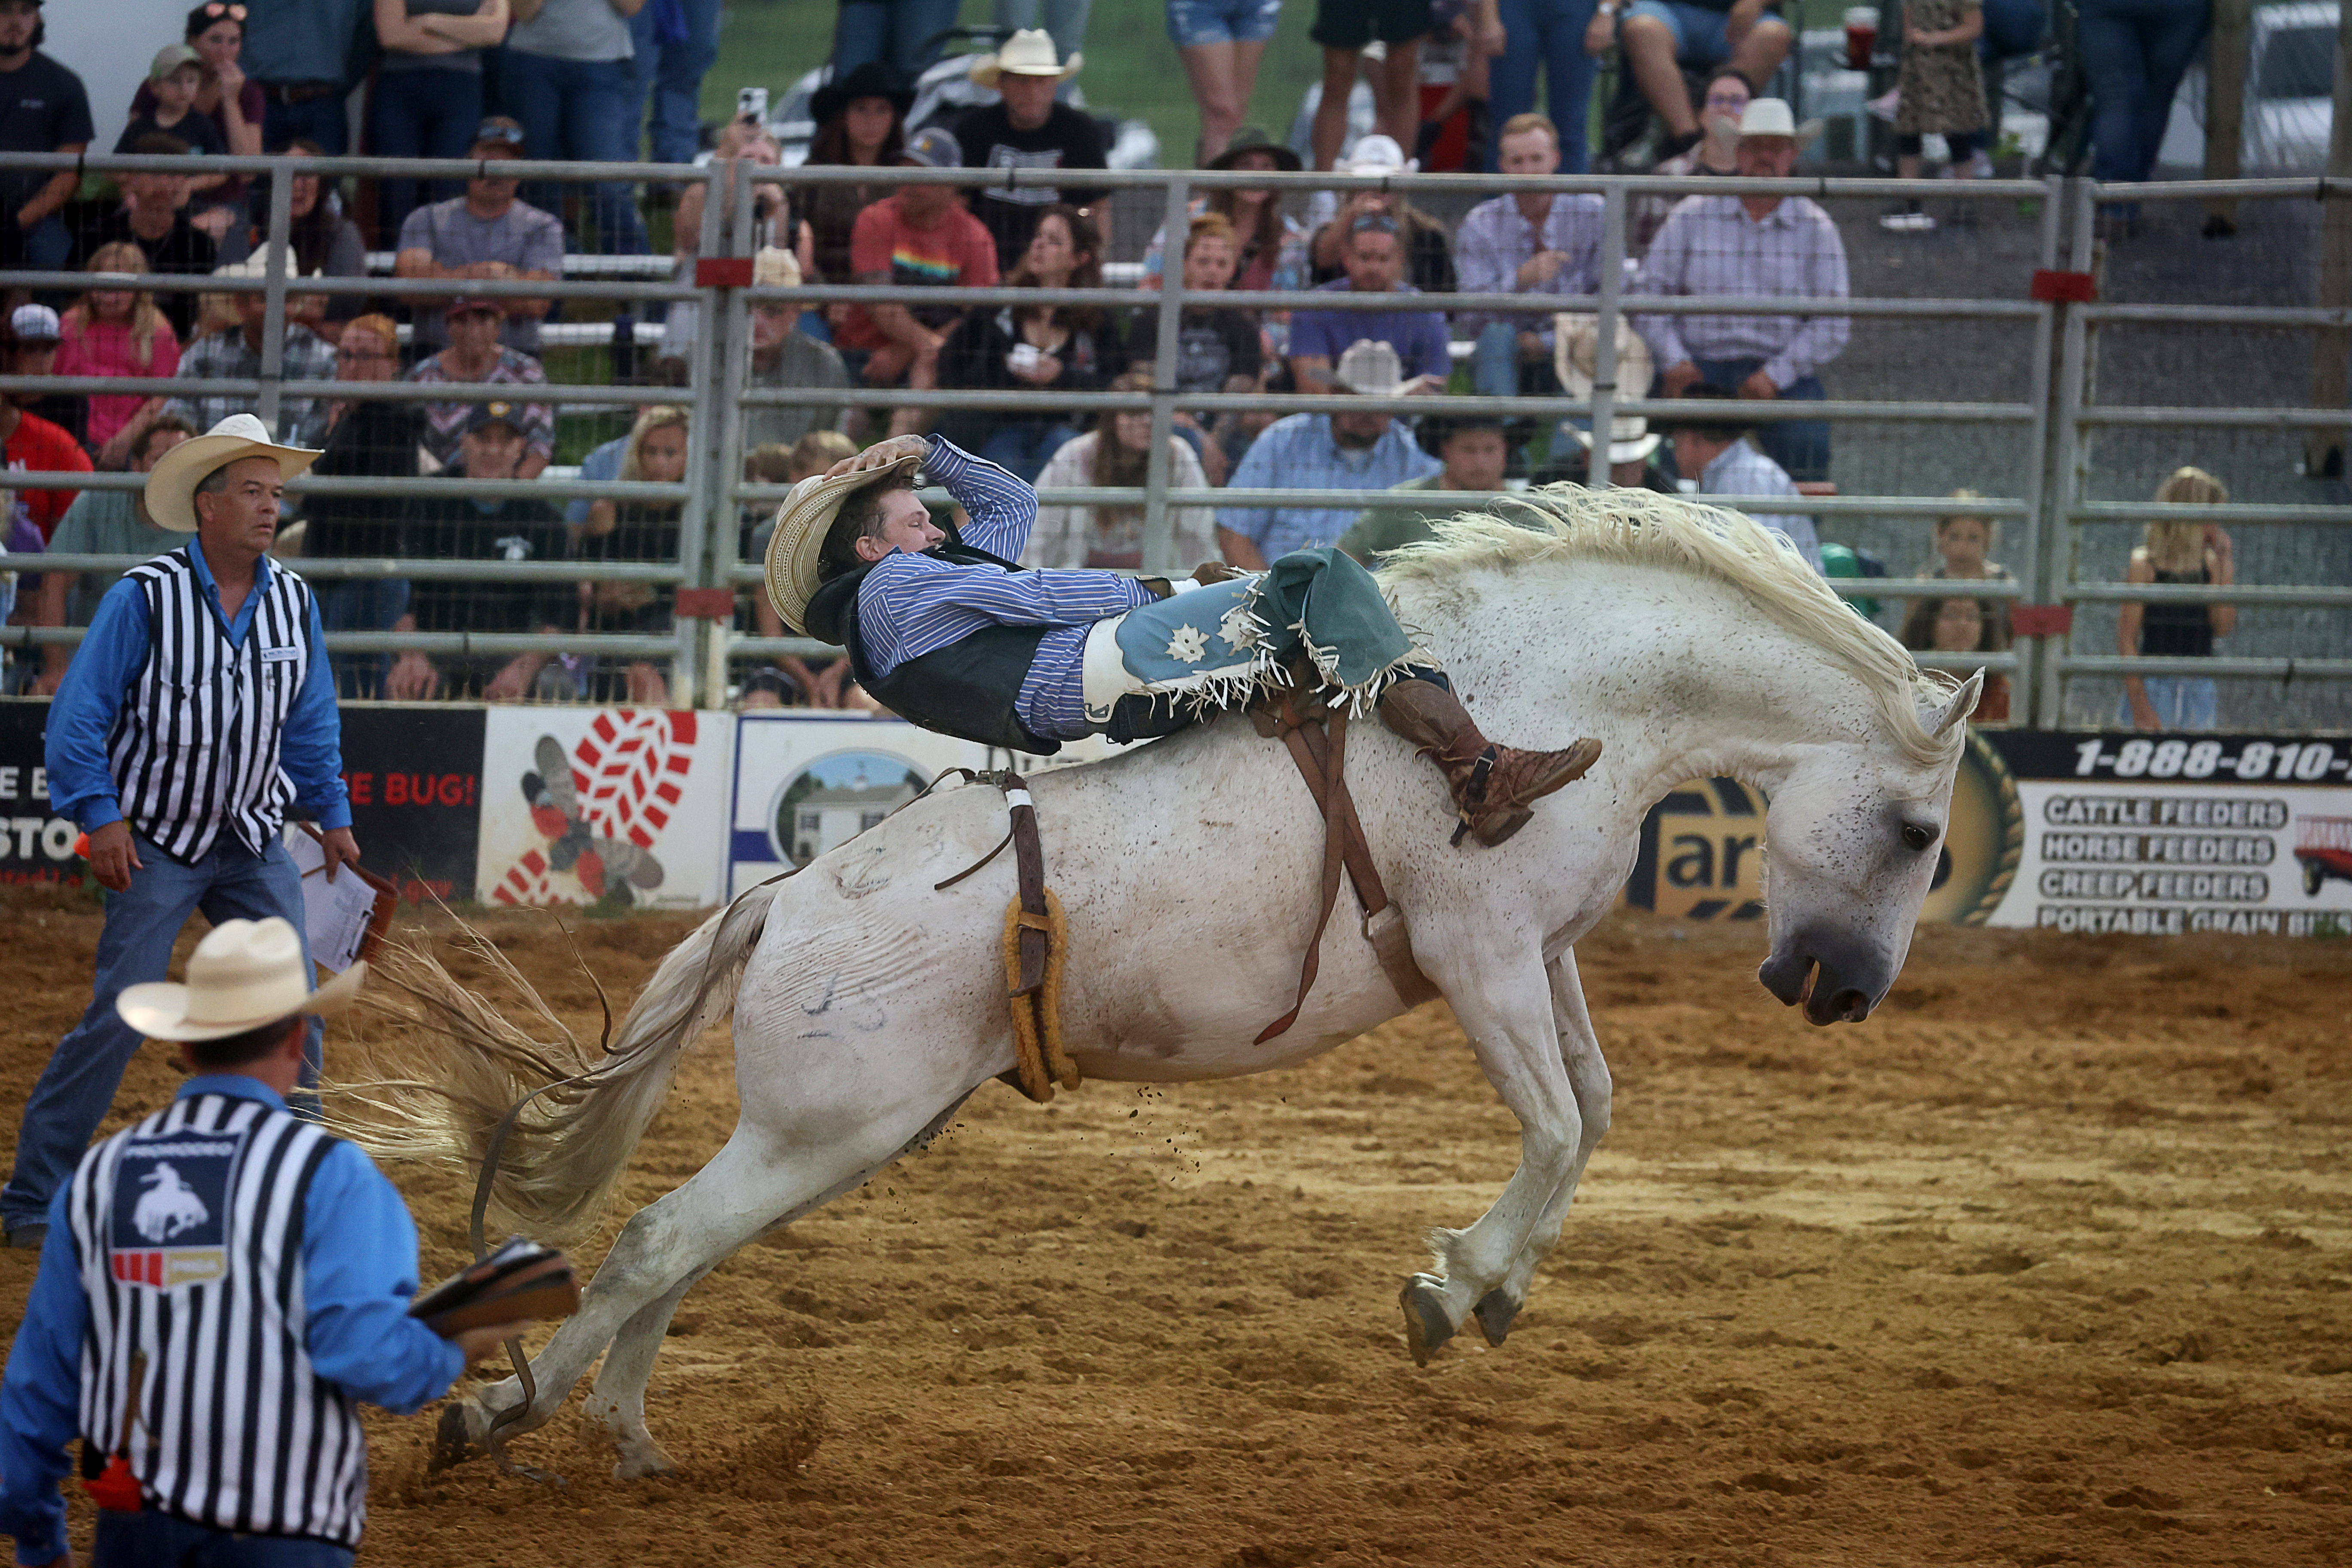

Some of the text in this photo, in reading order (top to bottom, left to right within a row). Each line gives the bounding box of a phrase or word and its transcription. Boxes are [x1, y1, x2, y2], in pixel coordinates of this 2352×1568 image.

[2075, 739, 2352, 781] 1-888-810-
[341, 773, 475, 807] E BUG!
[2047, 798, 2284, 827] CATTLE FEEDERS
[2046, 836, 2271, 862] HORSE FEEDERS
[2042, 872, 2264, 898] CREEP FEEDERS
[2040, 909, 2183, 934] PORTABLE
